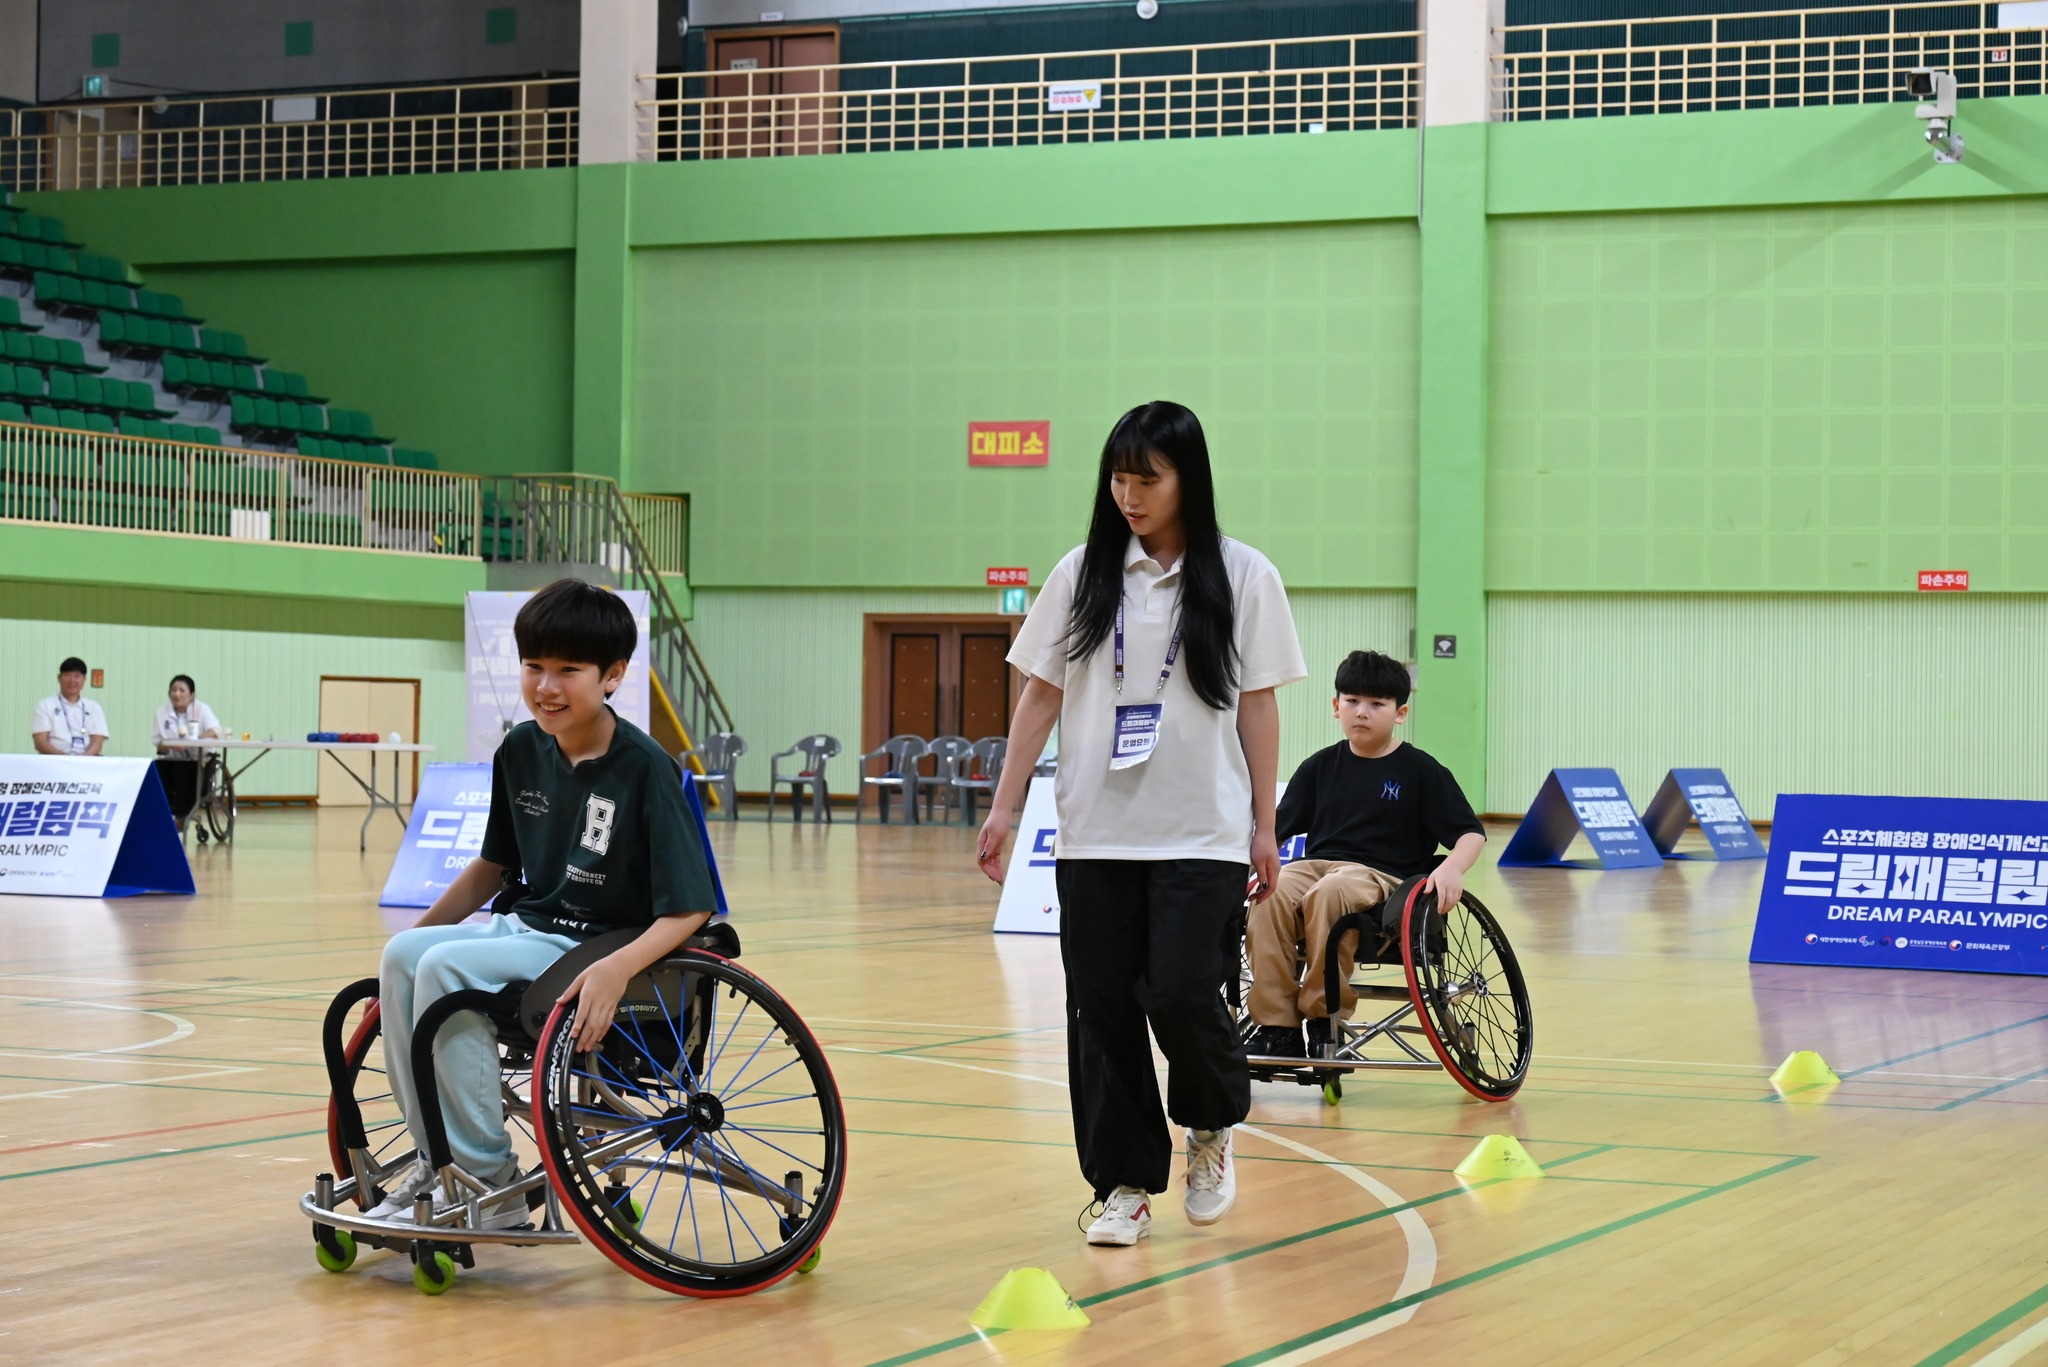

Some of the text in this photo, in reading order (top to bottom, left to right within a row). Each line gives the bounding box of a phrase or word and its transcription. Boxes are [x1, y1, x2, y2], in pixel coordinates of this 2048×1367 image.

[972, 431, 1045, 456] 대피소
[1920, 573, 1967, 587] 파손주의
[1821, 829, 1929, 849] 스포츠체험형
[1827, 904, 2048, 930] DREAM PARALYMPIC
